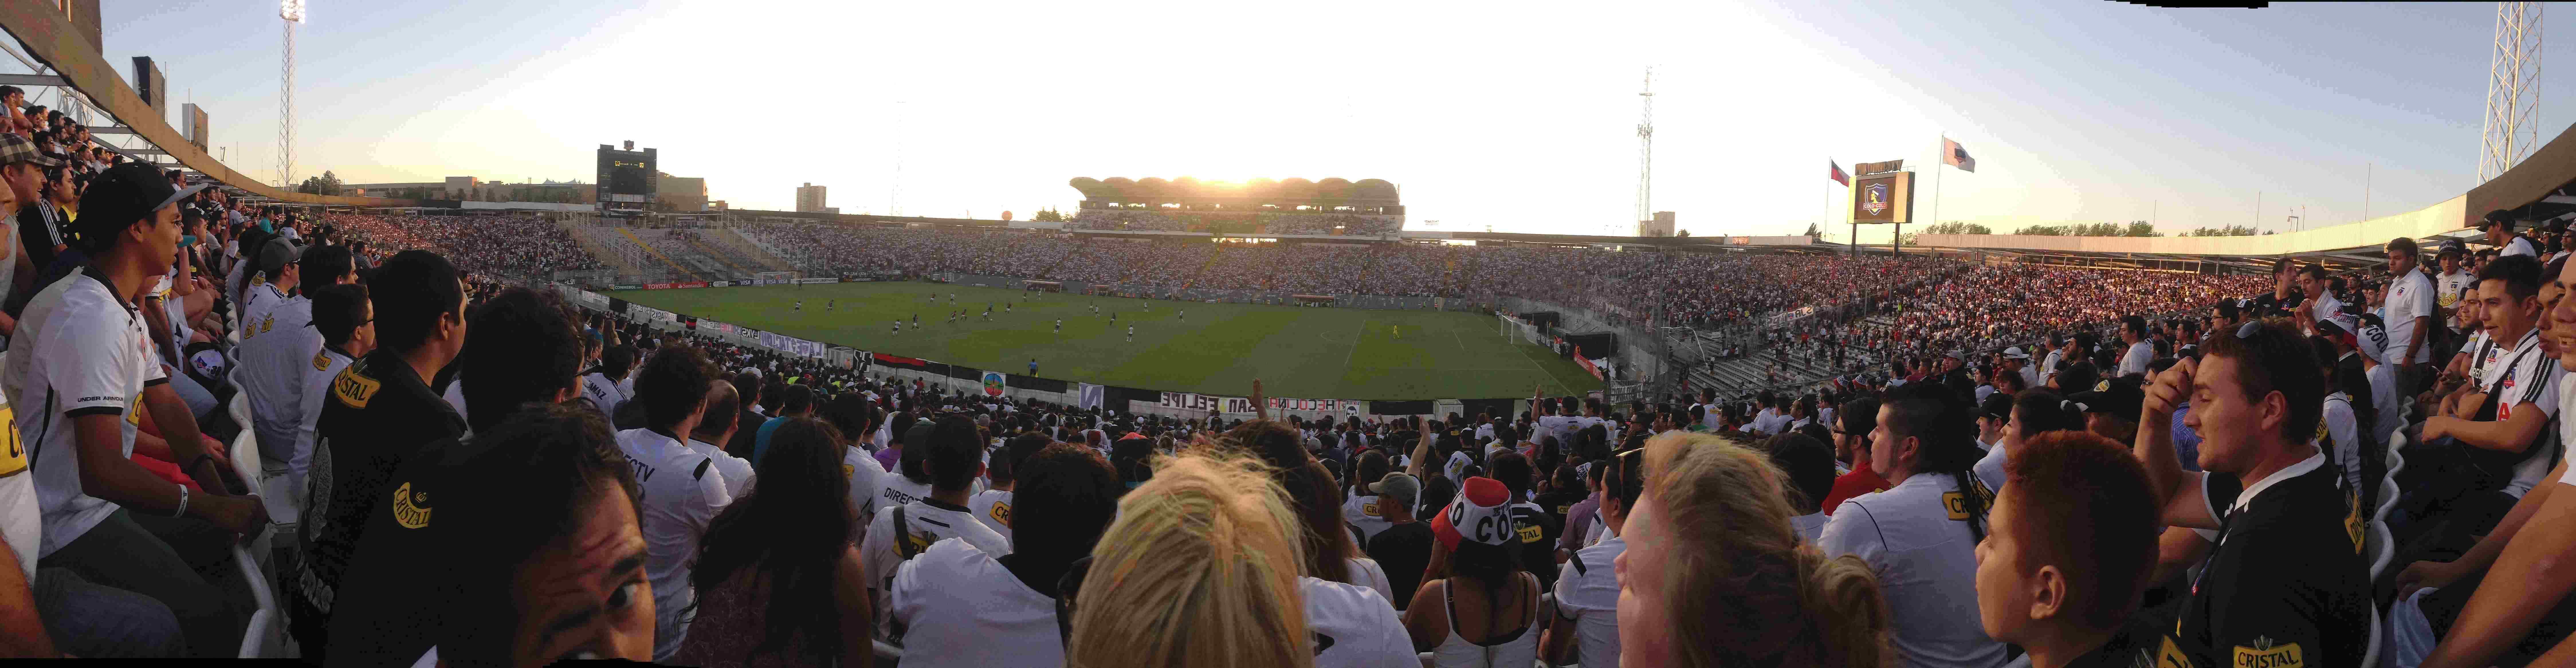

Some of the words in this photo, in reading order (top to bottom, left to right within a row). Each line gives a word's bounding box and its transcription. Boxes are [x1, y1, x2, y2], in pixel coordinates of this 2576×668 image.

[884, 487, 922, 505] DIREC
[396, 488, 429, 525] CRISTAL
[2238, 650, 2299, 668] CRISTAL
